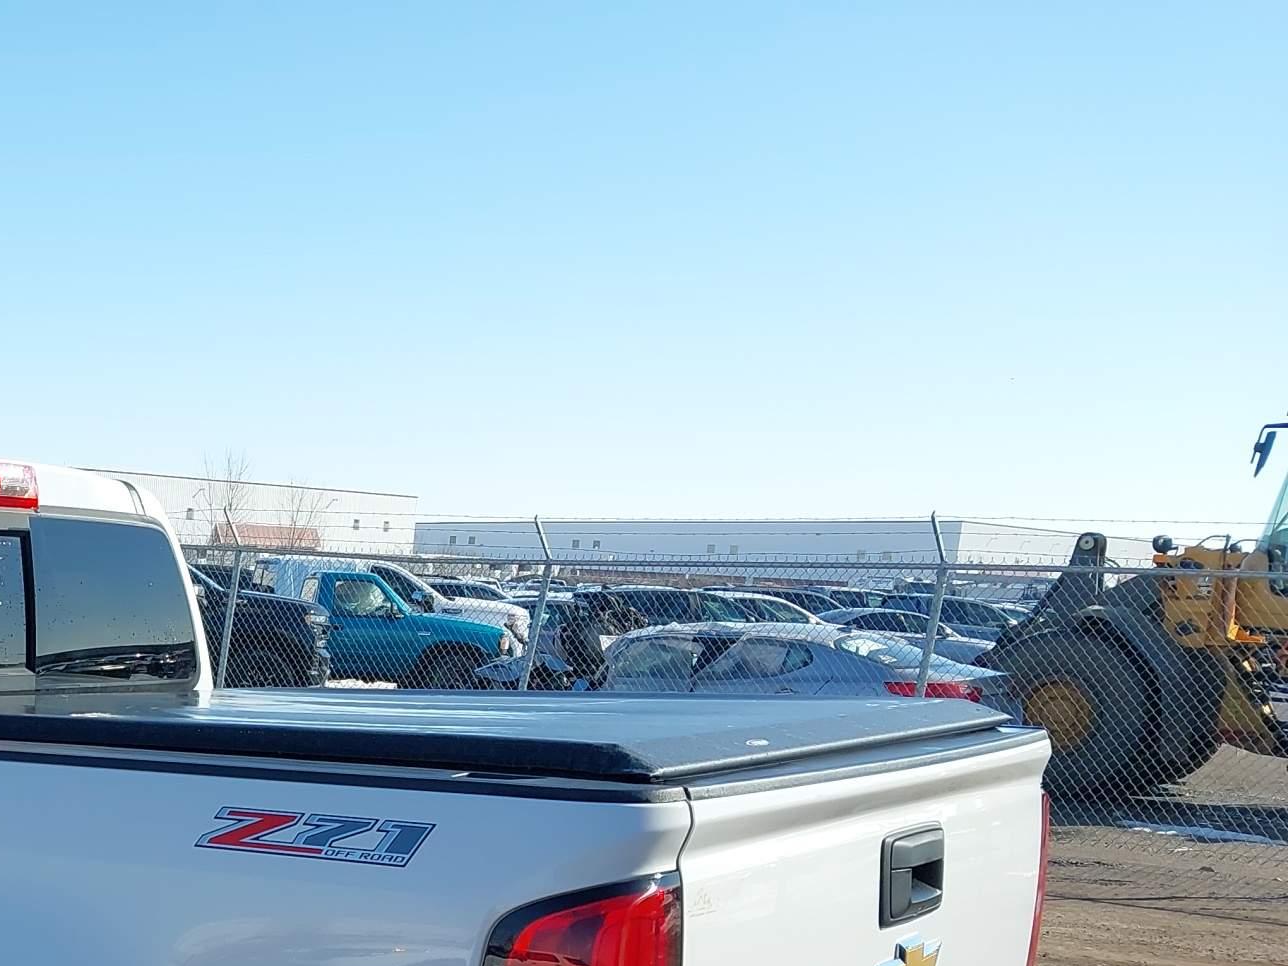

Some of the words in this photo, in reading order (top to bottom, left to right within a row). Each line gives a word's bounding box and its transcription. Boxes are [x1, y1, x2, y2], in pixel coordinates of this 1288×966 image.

[194, 806, 437, 867] Z71
[323, 848, 359, 860] OFF
[359, 851, 406, 864] ROAD
